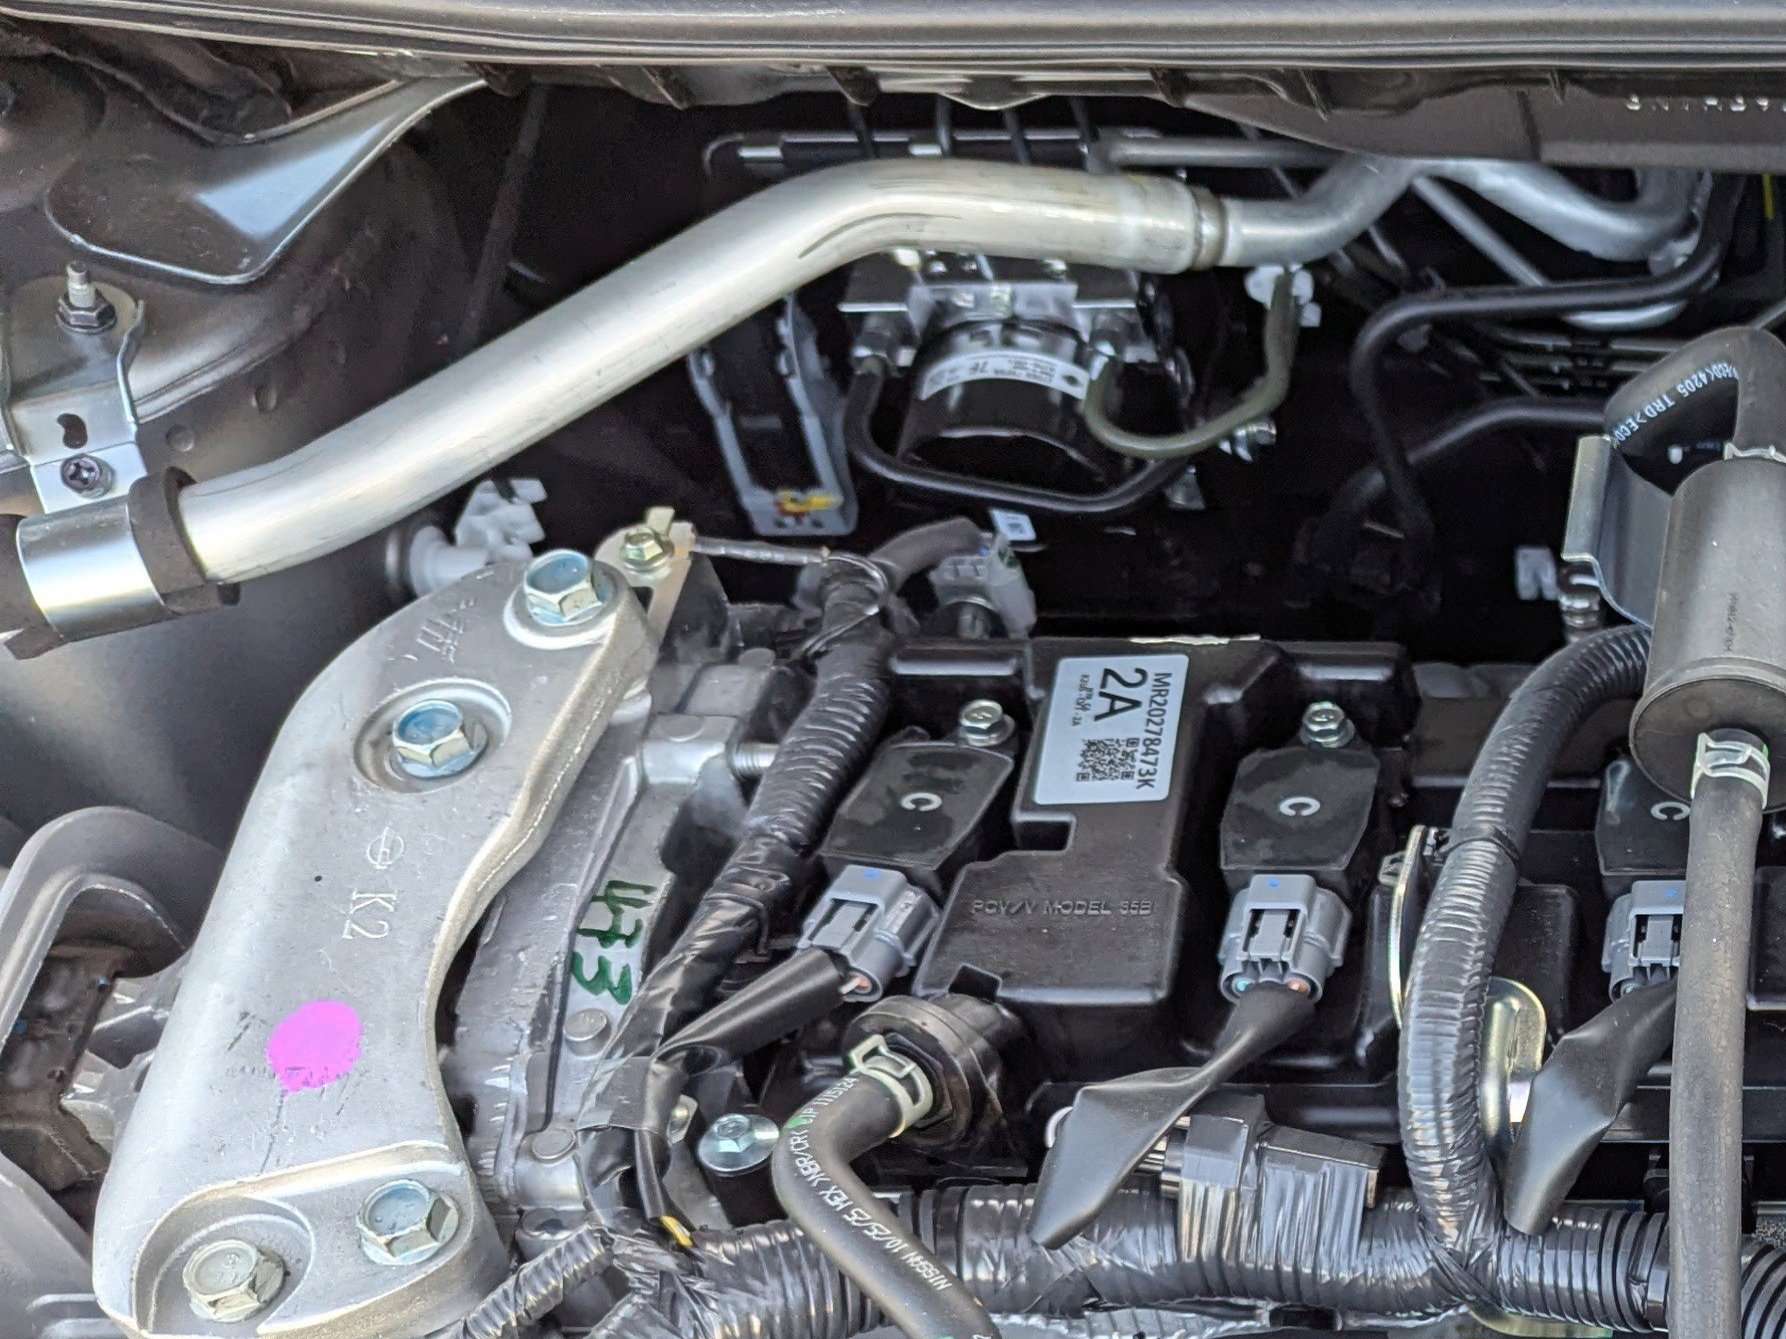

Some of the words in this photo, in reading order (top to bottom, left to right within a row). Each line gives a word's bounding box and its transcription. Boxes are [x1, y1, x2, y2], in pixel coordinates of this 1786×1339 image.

[1093, 667, 1149, 722] 2A
[900, 792, 943, 812] C
[1279, 796, 1321, 817] C
[1042, 899, 1112, 916] MODEL
